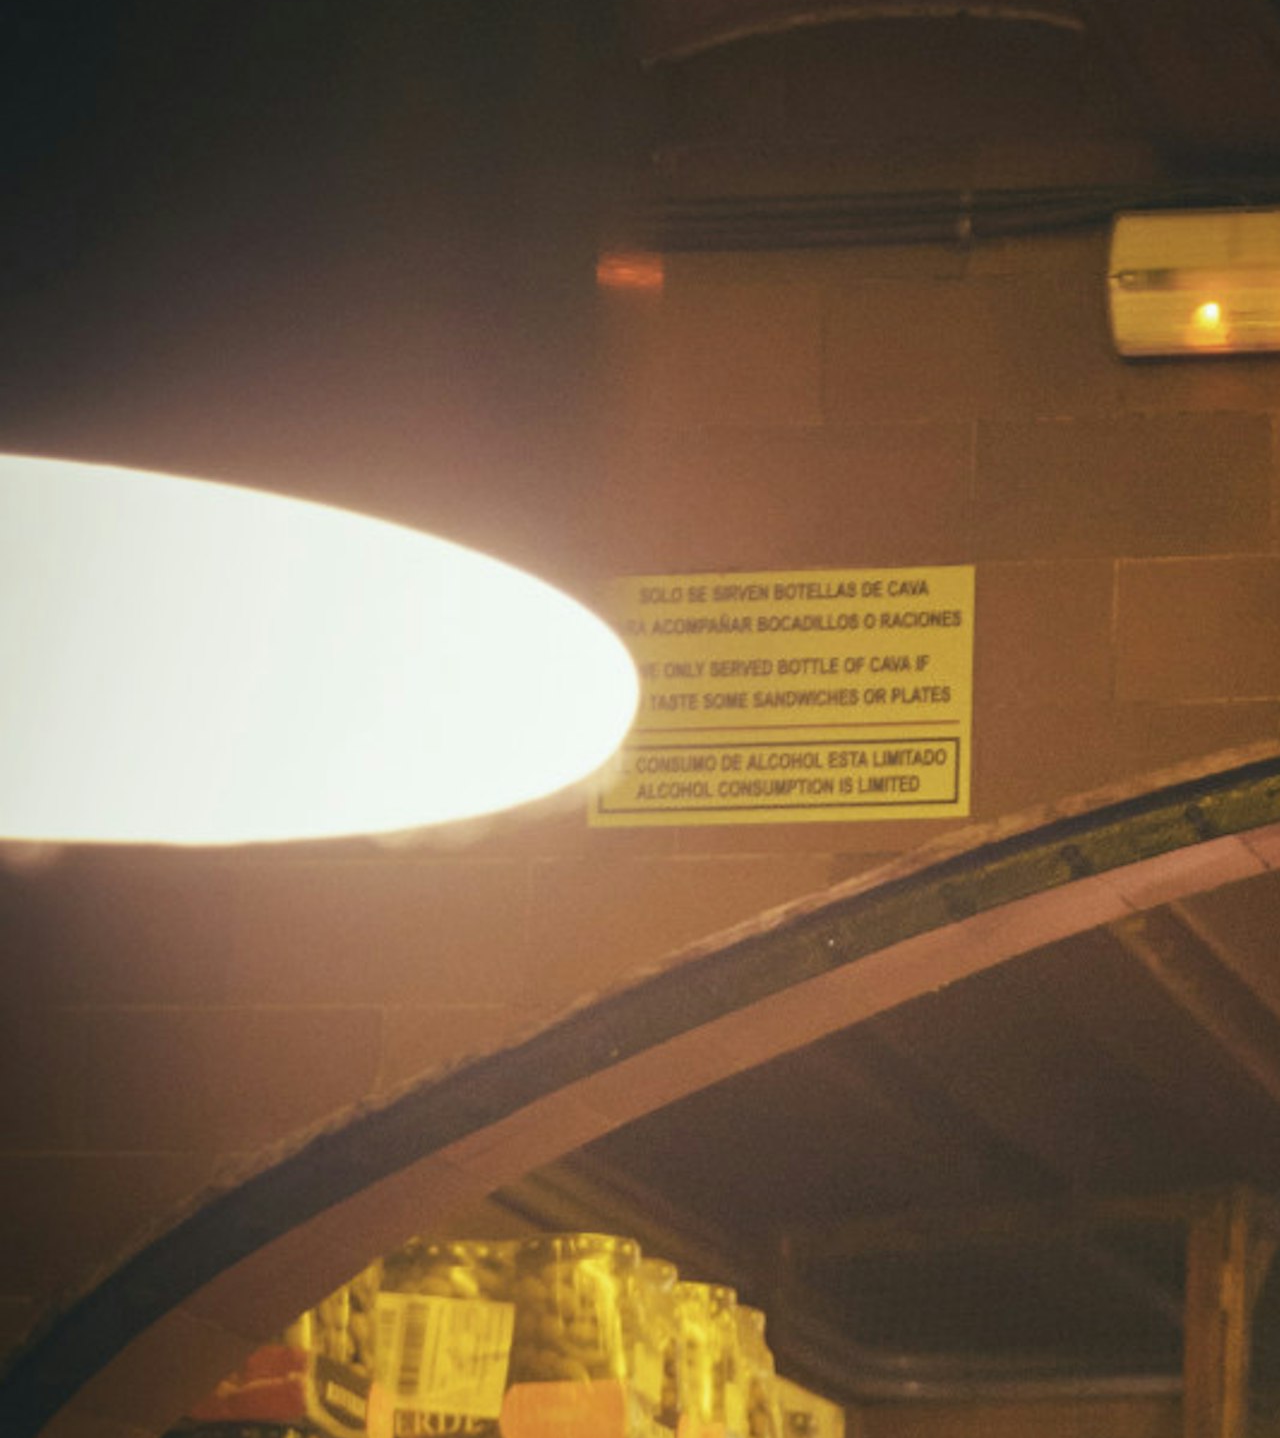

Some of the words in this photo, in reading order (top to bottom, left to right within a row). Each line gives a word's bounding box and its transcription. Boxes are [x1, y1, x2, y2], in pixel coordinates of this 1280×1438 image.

[640, 587, 682, 604] SOLO
[688, 586, 708, 602] SE
[712, 585, 769, 602] SIRVEN
[774, 582, 857, 600] BOTELLAS
[861, 581, 884, 598] DE
[888, 580, 930, 597] CAVA
[652, 614, 753, 635] ACOMPAÑAR
[757, 612, 859, 632] BOCADILLOS
[864, 613, 876, 629] O
[880, 610, 962, 628] RACIONES
[664, 661, 707, 678] ONLY
[710, 658, 773, 676] SERVED
[777, 657, 839, 674] BOTTLE
[844, 656, 865, 673] OF
[869, 655, 911, 672] CAVA
[916, 654, 931, 671] IF
[650, 693, 699, 711] TASTE
[703, 692, 748, 709] SOME
[753, 688, 859, 708] SANDWICHES
[863, 687, 887, 704] OR
[891, 685, 952, 703] PLATES
[635, 754, 717, 773] CONSUMO
[721, 753, 743, 771] DE
[746, 751, 823, 770] ALCOHOL
[828, 750, 869, 768] ESTA
[873, 747, 948, 766] LIMITADO
[636, 781, 713, 801] ALCOHOL
[718, 777, 834, 798] CONSUMPTION
[839, 776, 854, 794] IS
[858, 774, 921, 793] LIMITED
